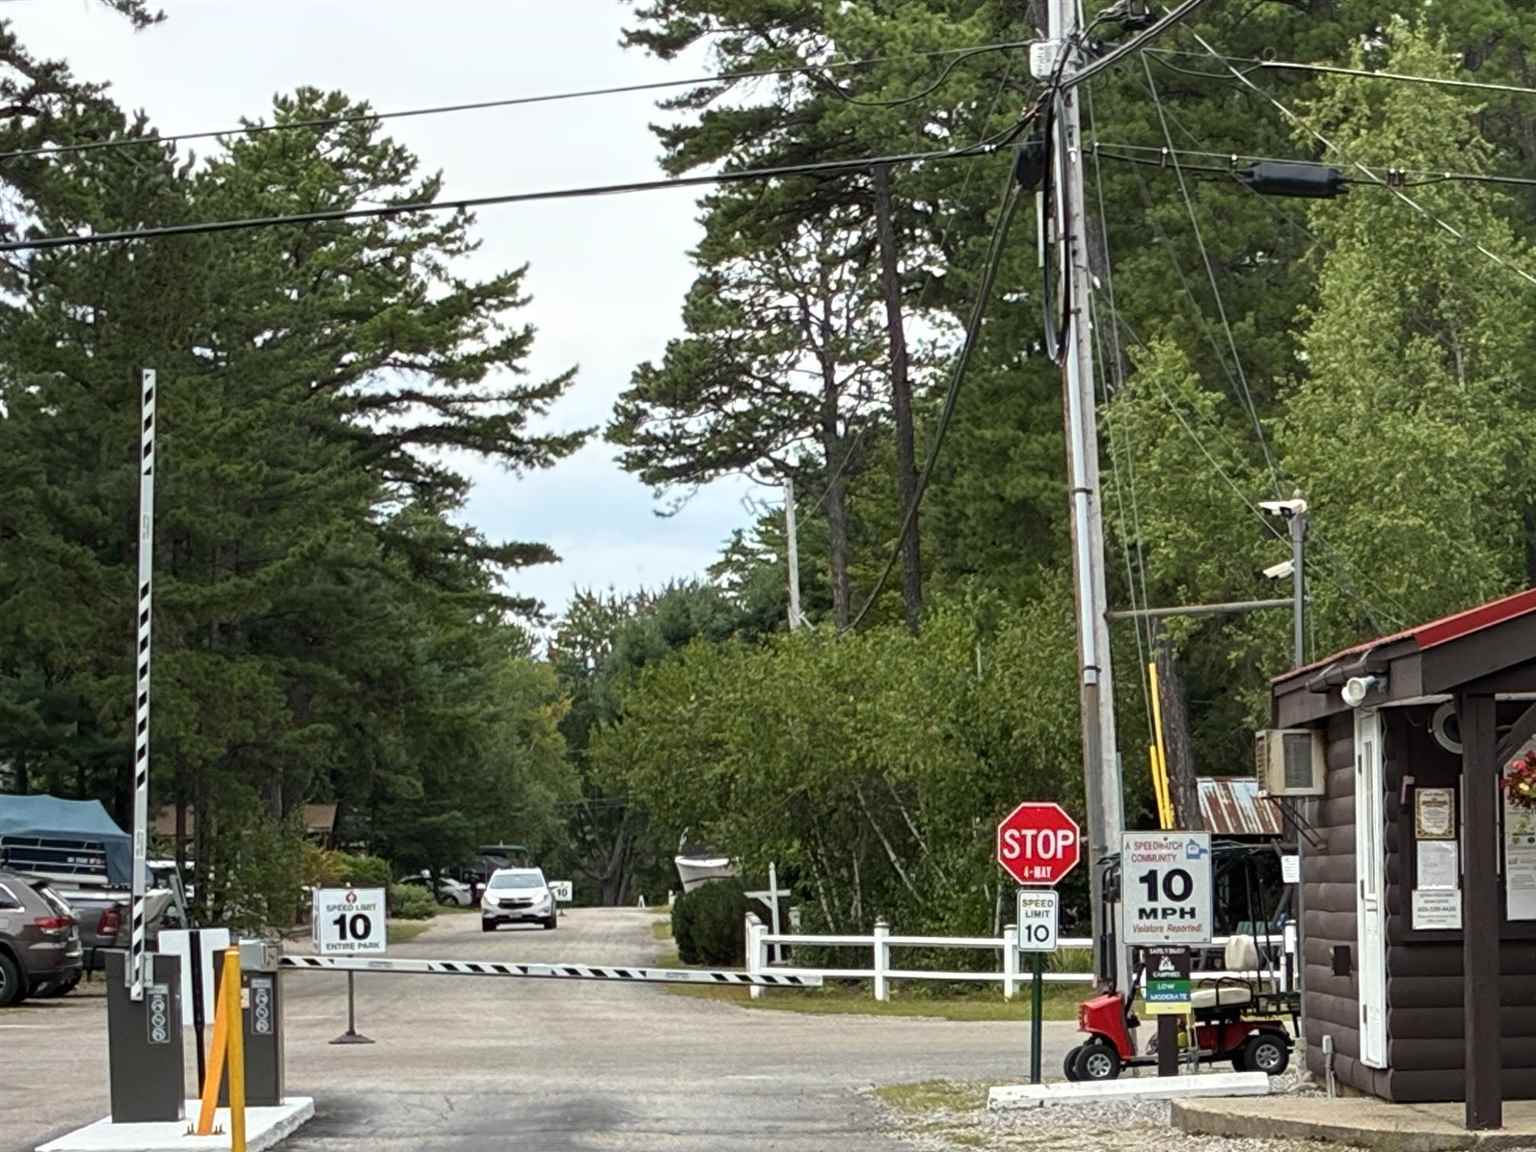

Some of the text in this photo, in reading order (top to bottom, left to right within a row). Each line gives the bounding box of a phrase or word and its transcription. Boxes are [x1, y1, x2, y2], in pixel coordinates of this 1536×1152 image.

[1002, 829, 1075, 860] STOP
[1138, 868, 1194, 902] 10
[1022, 900, 1054, 908] SPEED
[1025, 910, 1051, 918] LIMIT
[1138, 907, 1196, 920] MPH
[333, 913, 372, 940] 10
[1025, 924, 1050, 942] 10
